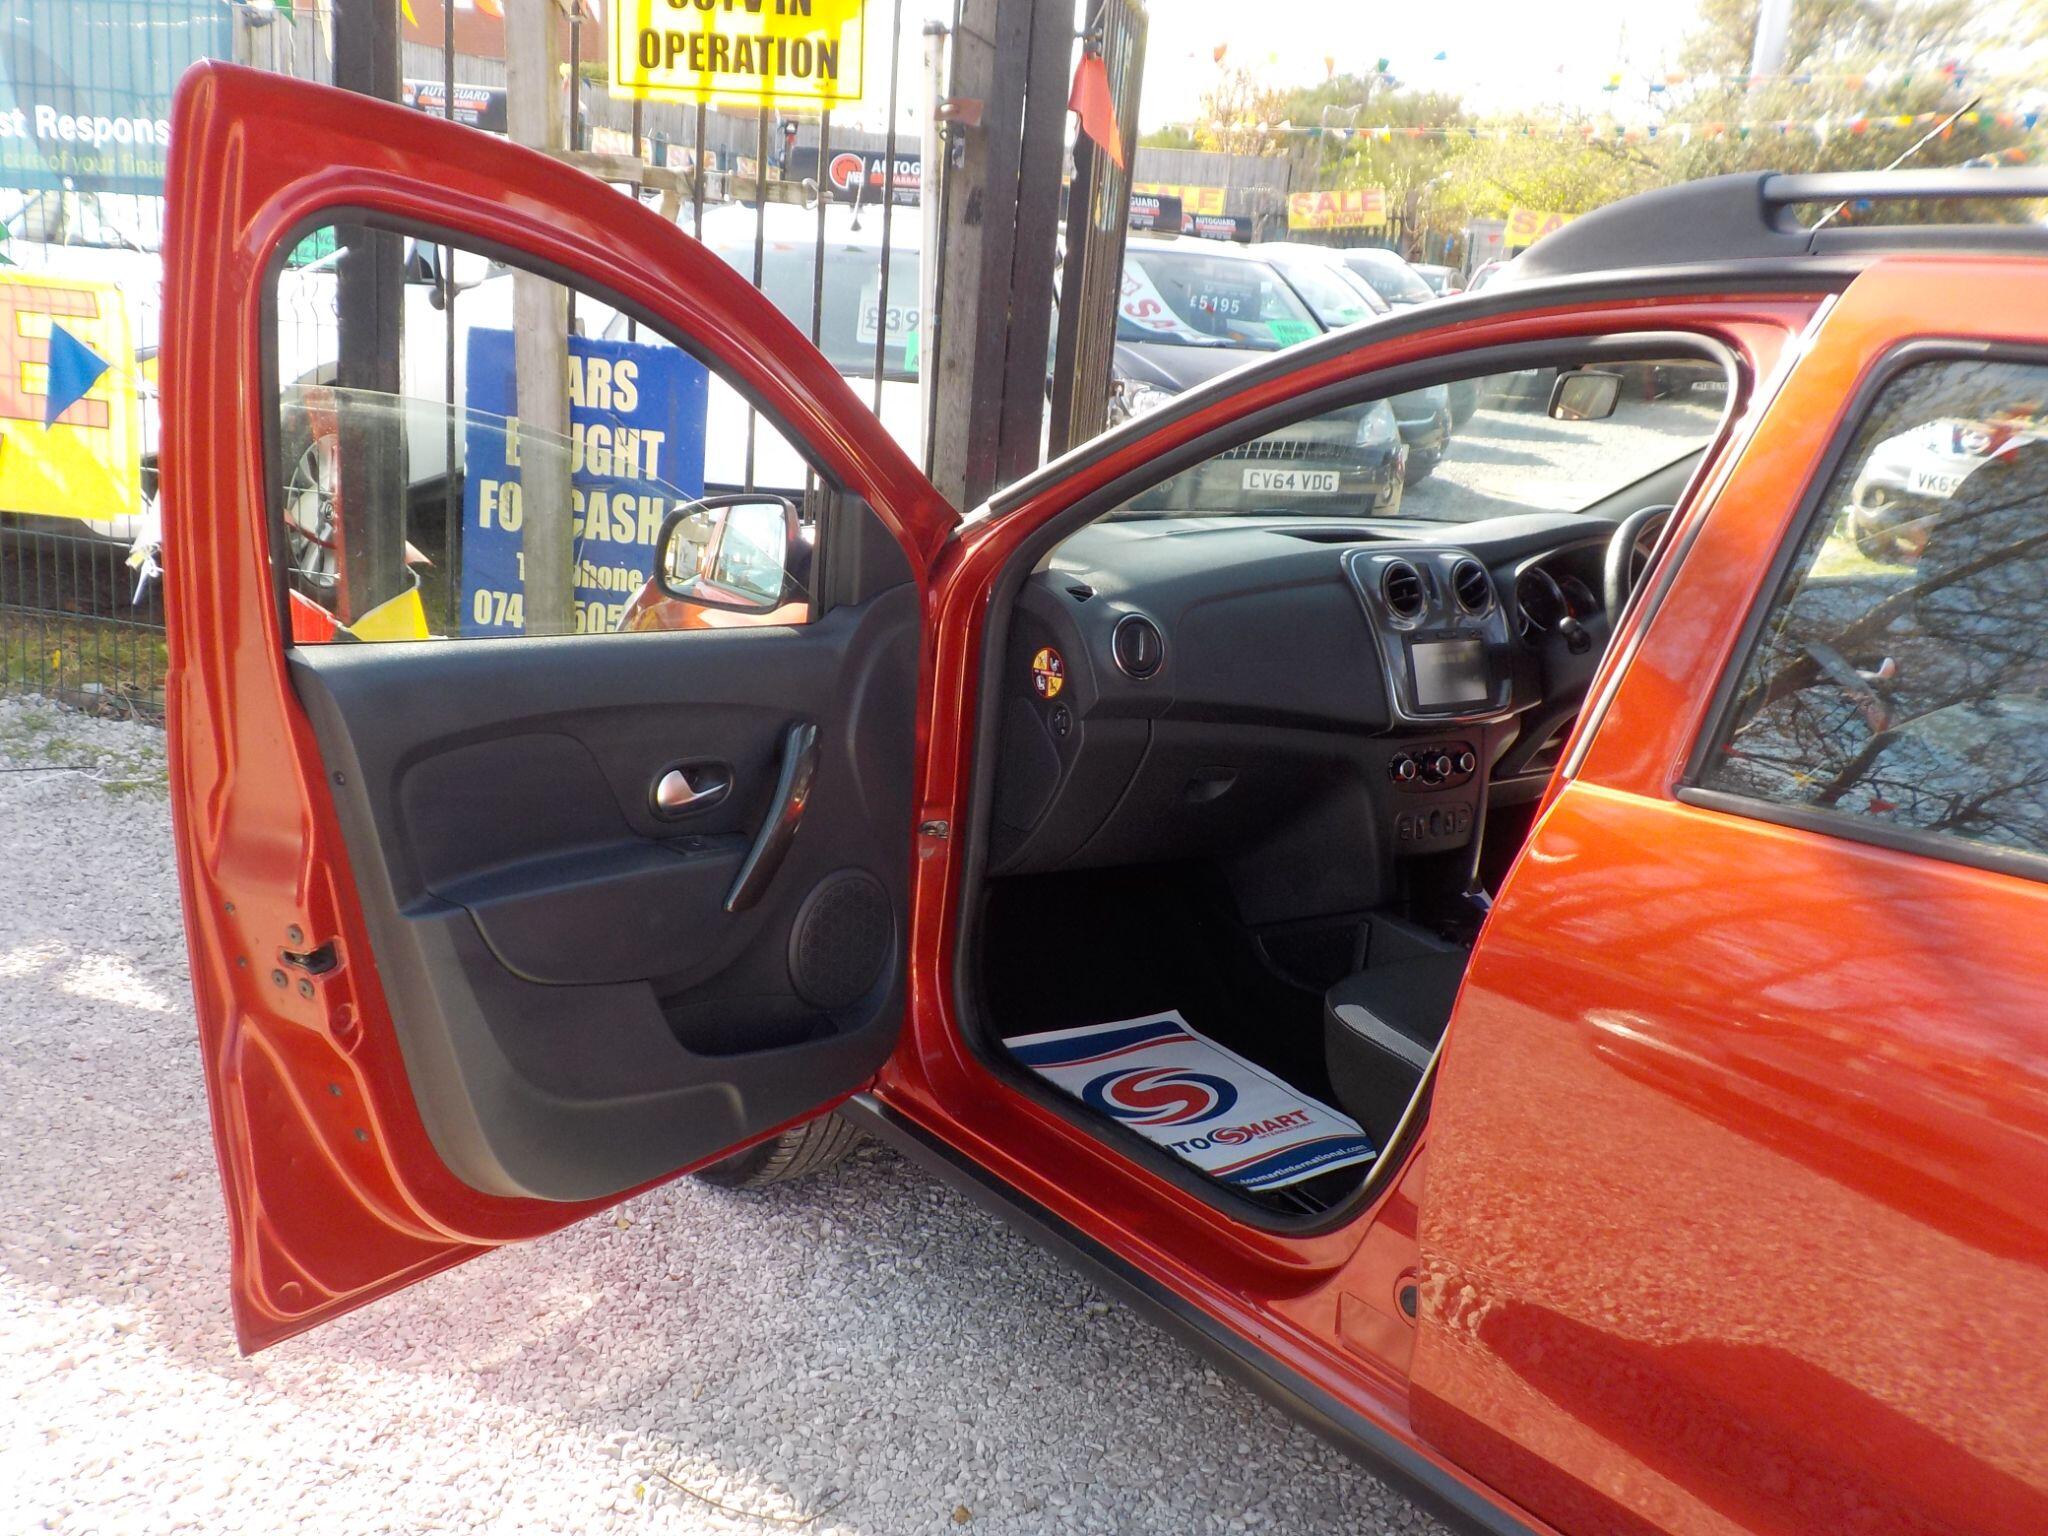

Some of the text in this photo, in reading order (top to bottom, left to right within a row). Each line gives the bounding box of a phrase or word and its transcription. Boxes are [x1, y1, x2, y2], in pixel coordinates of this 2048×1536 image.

[638, 28, 839, 80] OPERATION
[50, 151, 69, 173] of
[1291, 187, 1383, 215] SALE
[1332, 212, 1364, 225] NOW
[1190, 294, 1240, 315] £5195
[569, 355, 639, 413] ARS
[1249, 471, 1296, 490] CV64
[478, 479, 524, 533] FO
